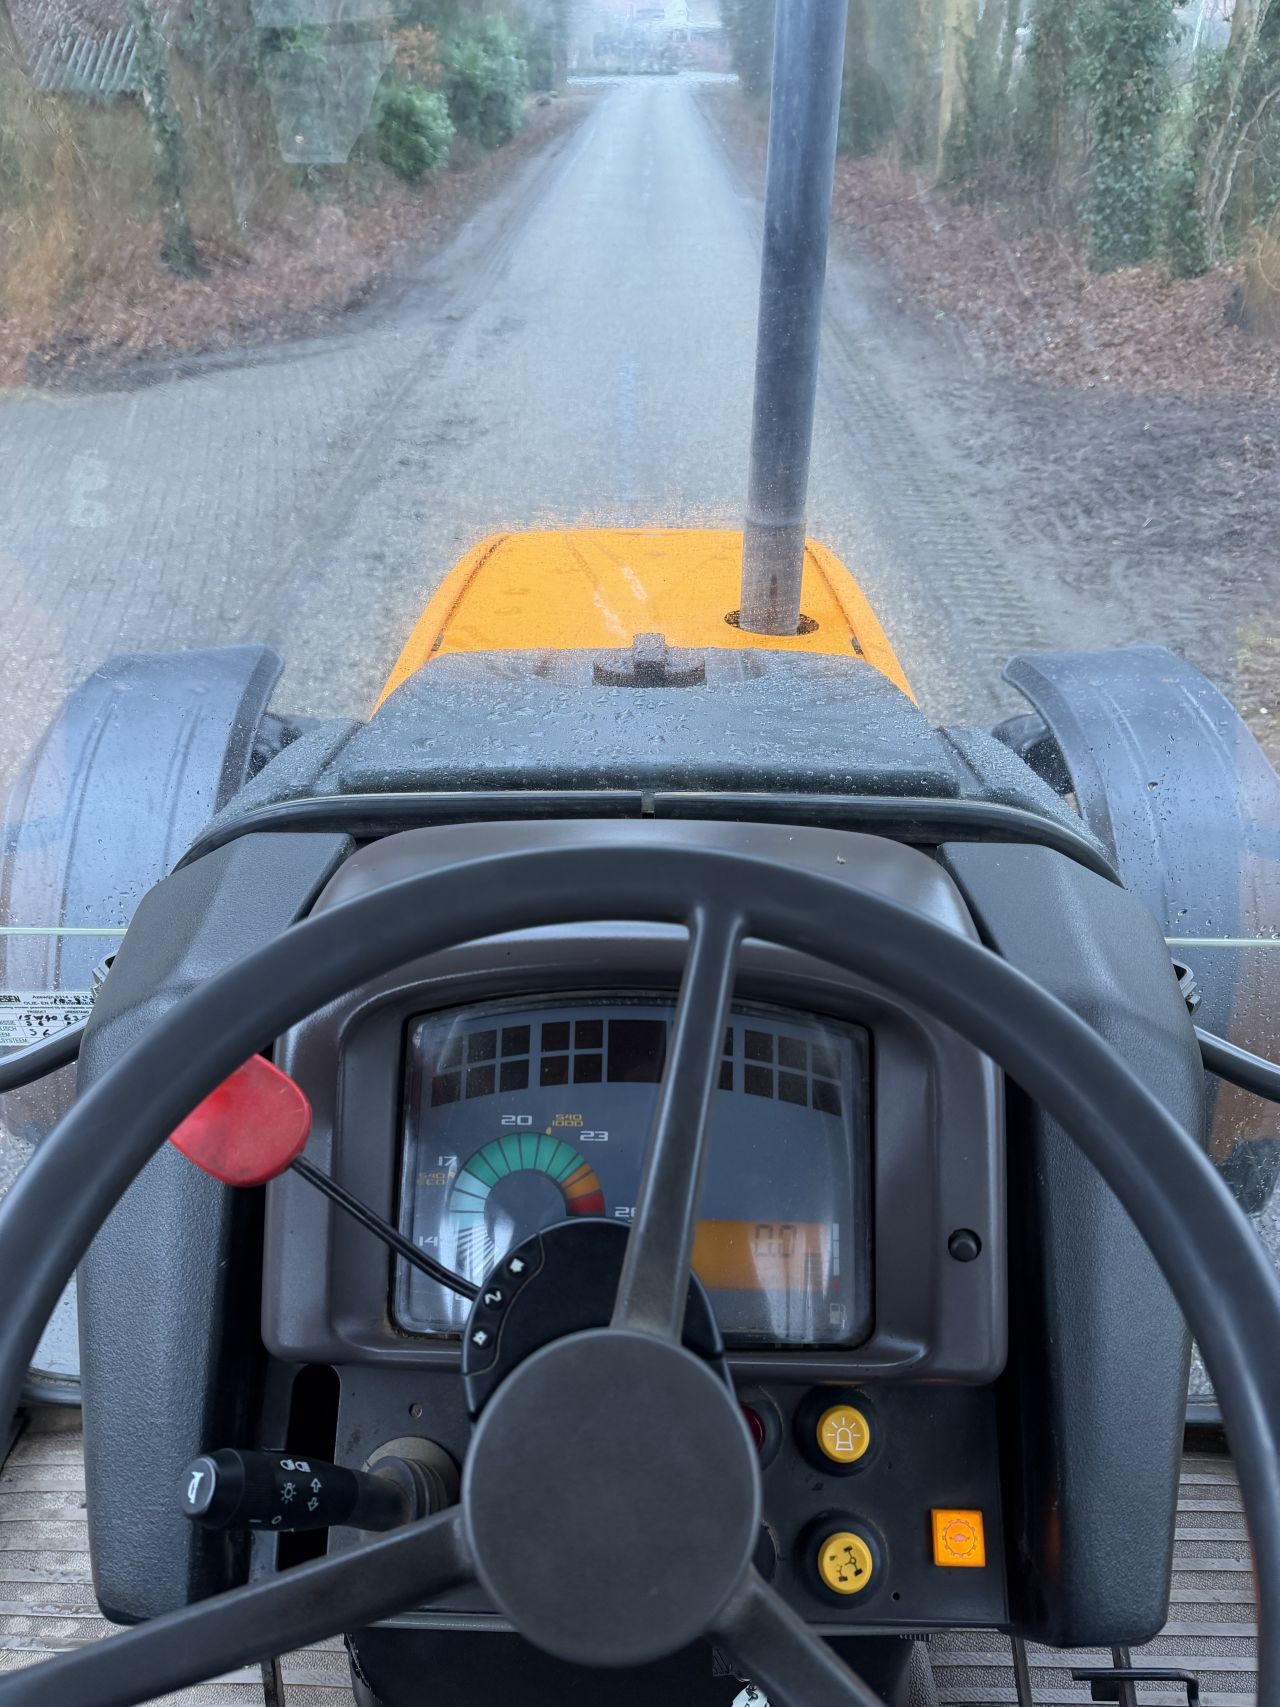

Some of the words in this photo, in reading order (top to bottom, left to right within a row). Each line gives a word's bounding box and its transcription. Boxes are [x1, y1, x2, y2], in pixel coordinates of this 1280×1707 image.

[500, 1114, 533, 1126] 20
[555, 1113, 583, 1121] 540
[579, 1130, 609, 1142] 23
[438, 1155, 458, 1167] 17
[418, 1235, 439, 1247] 14
